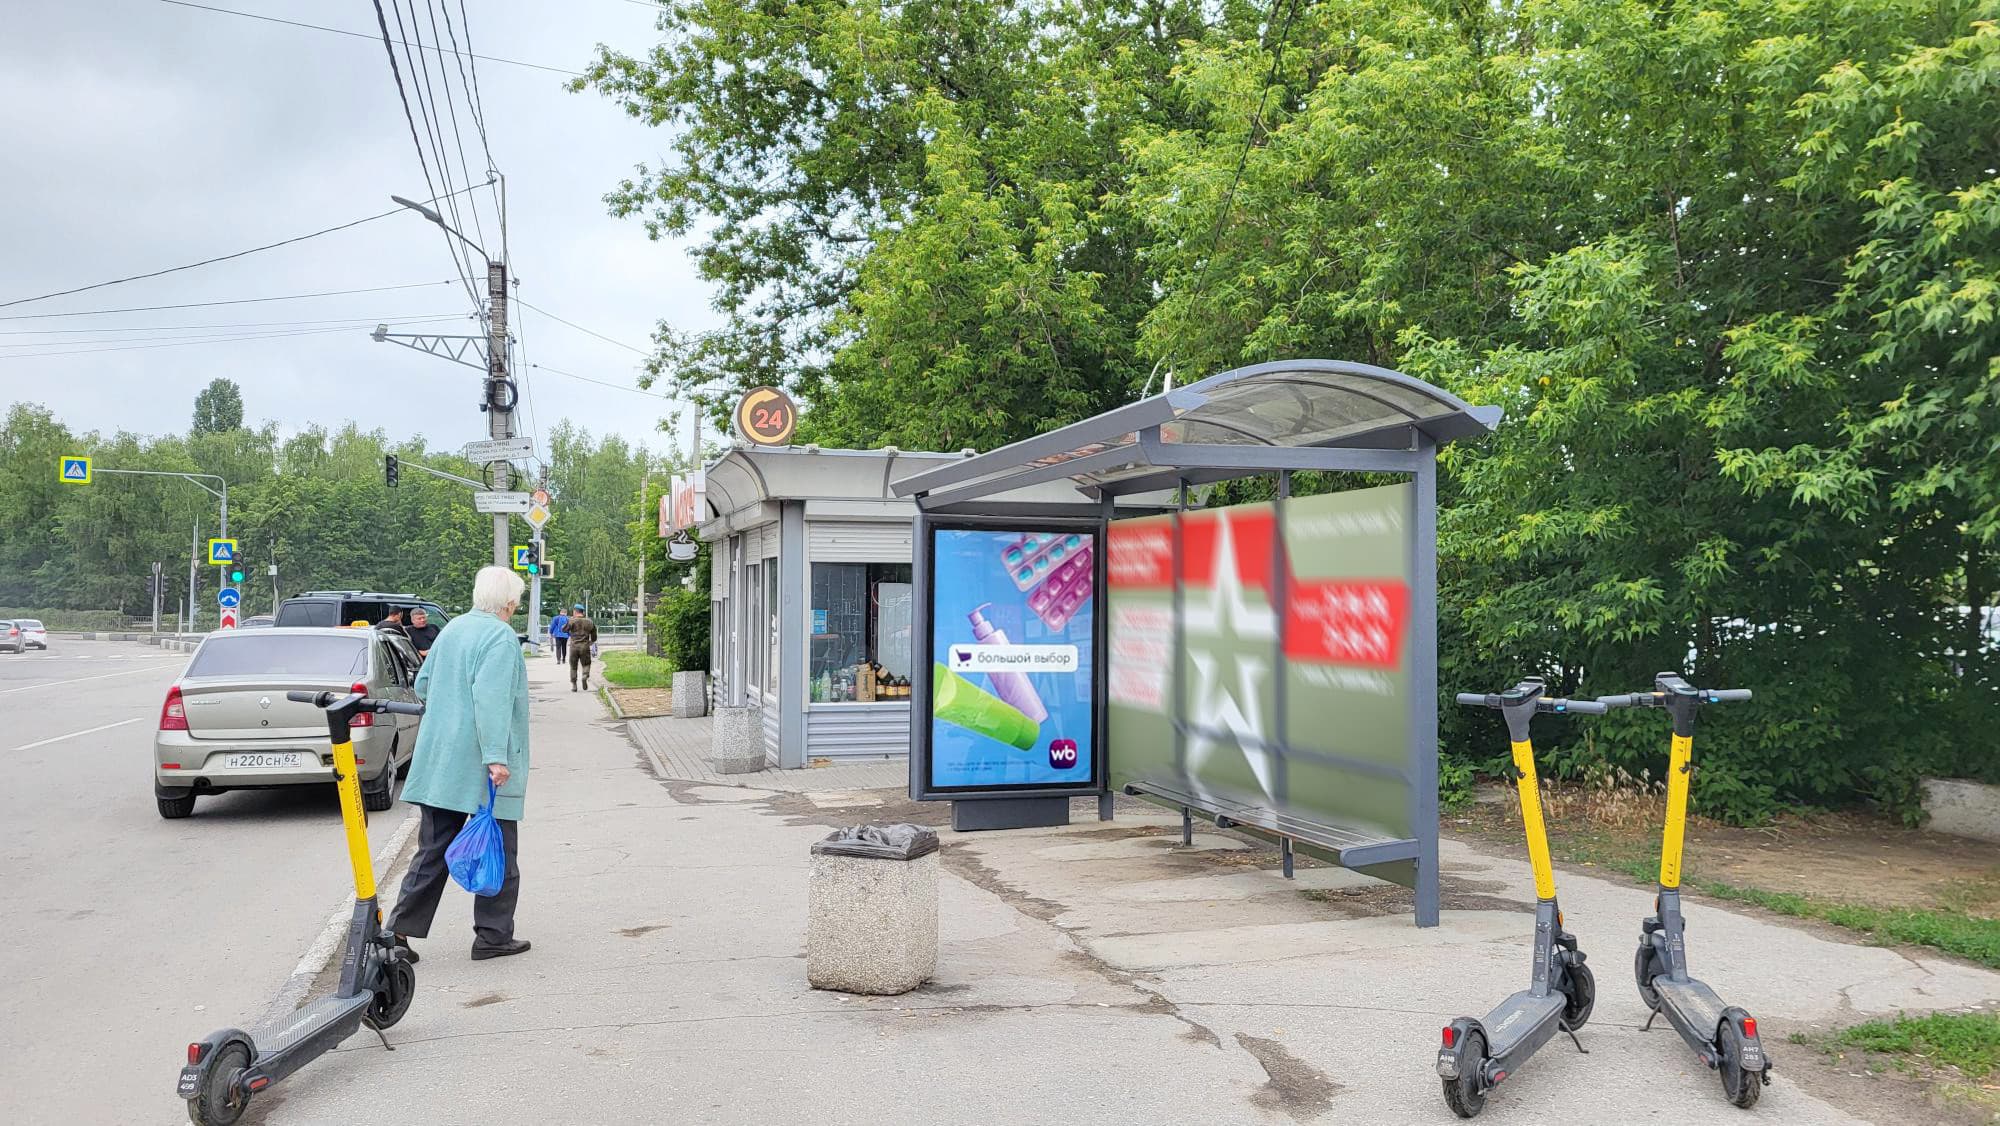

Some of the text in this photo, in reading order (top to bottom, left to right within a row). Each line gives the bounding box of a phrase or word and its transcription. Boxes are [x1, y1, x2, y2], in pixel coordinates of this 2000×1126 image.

[755, 408, 783, 430] 24
[977, 652, 1071, 665] большой выбор
[284, 753, 297, 763] 62
[1050, 745, 1076, 761] wb
